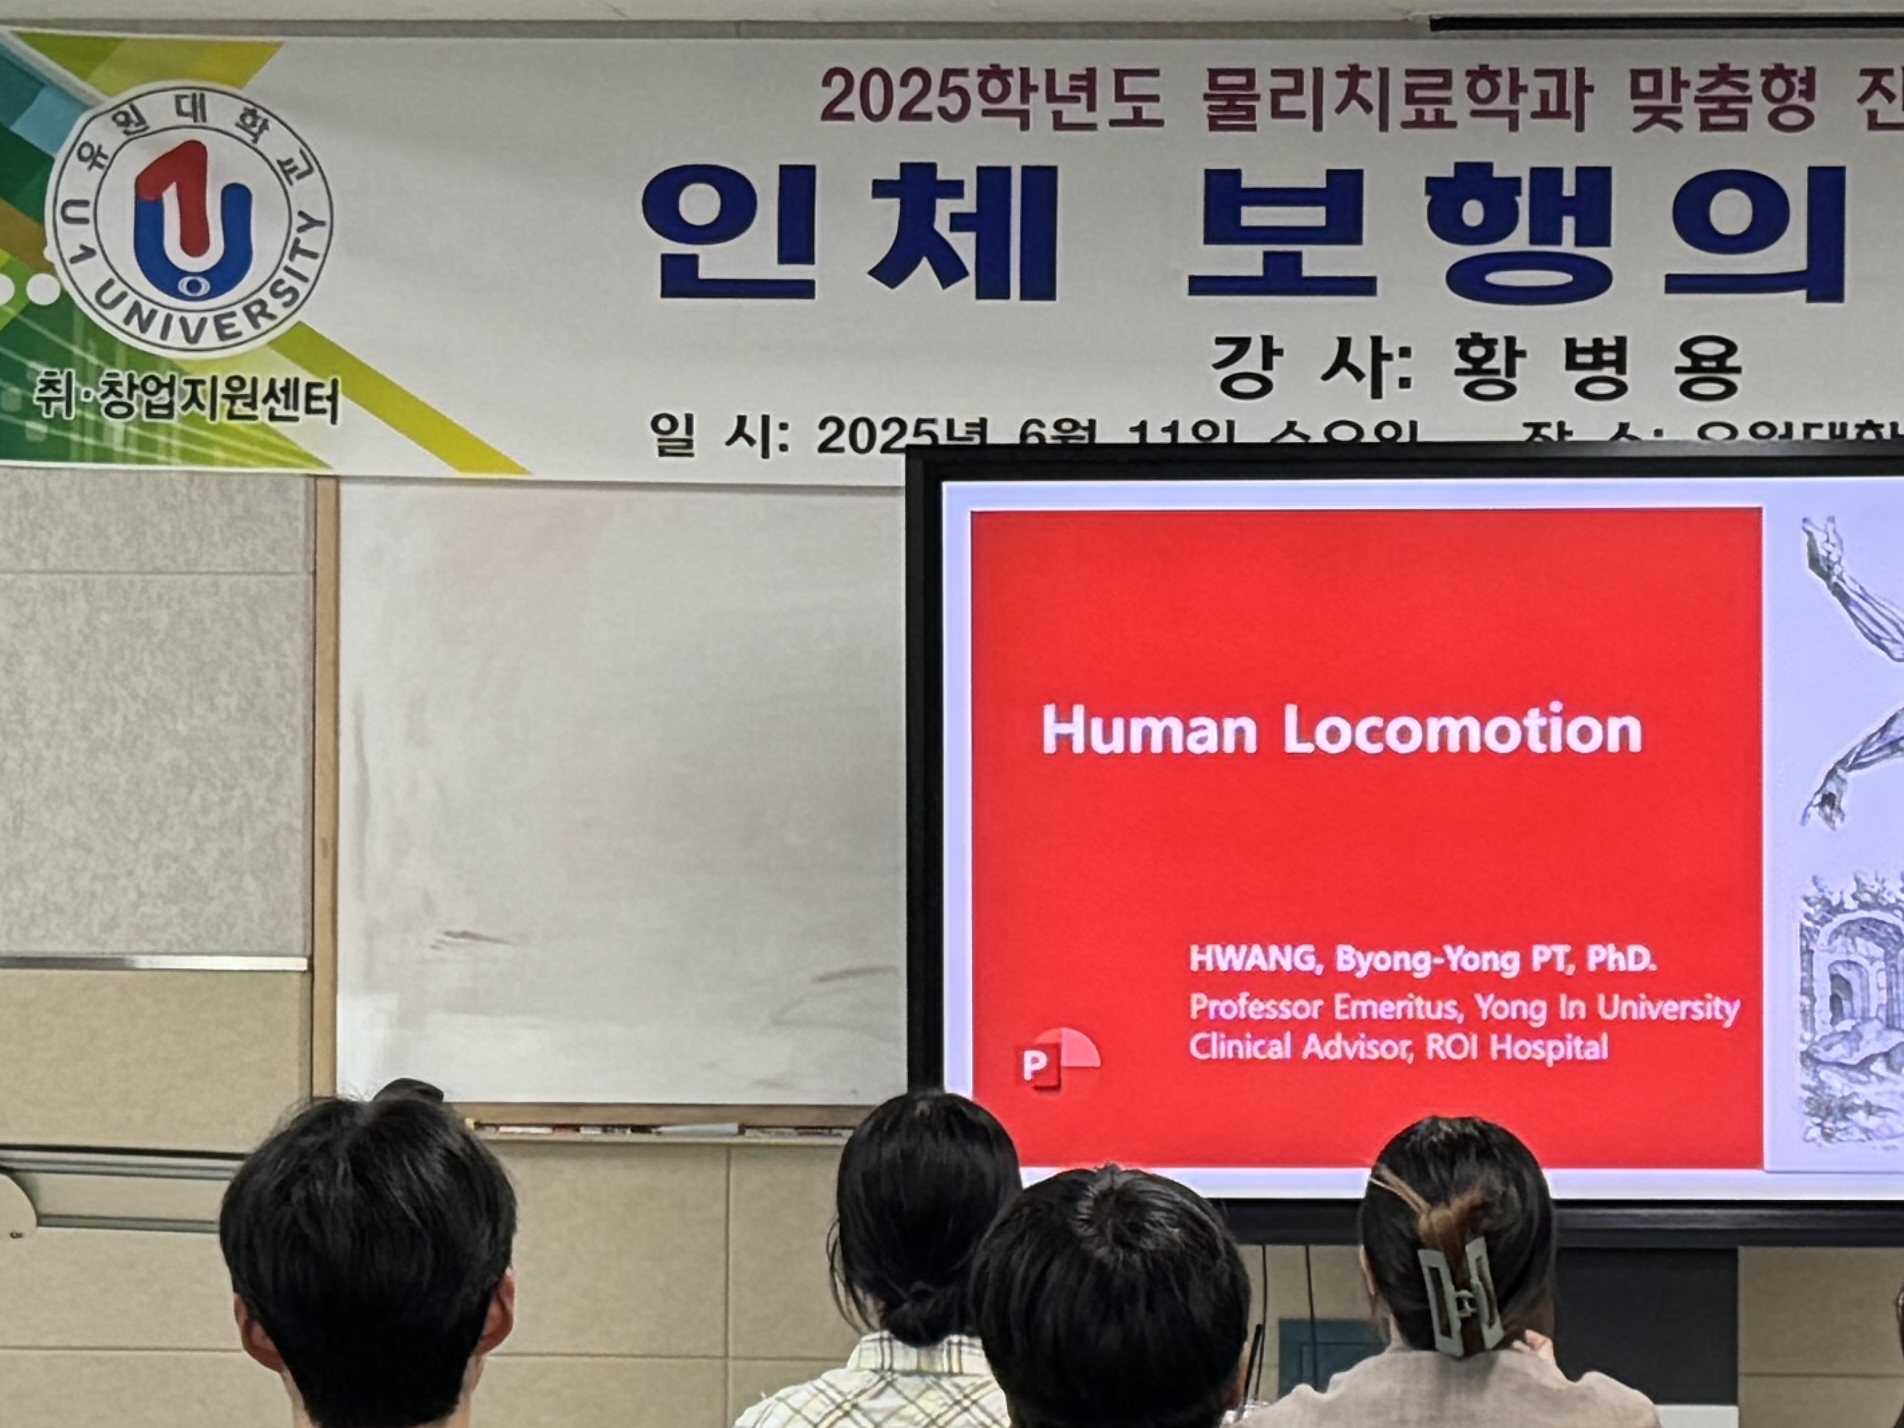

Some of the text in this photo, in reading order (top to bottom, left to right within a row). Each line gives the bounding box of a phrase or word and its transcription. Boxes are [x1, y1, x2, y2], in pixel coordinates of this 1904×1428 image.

[819, 62, 1166, 133] 2025학년도
[1202, 61, 1594, 134] 물리치료학과
[1628, 61, 1818, 134] 맞춤형
[76, 92, 316, 187] 유원대학교
[641, 161, 1059, 302] 인체
[1187, 160, 1847, 307] 보행의
[94, 210, 327, 346] UNIVERSITY
[1043, 700, 1642, 755] Human Locomotion
[1190, 943, 1657, 979] HWANG, Byong-Yong PT, PhD.
[1190, 991, 1741, 1028] Professor Emeritus, Yong In University
[1189, 1030, 1609, 1068] Clinical Advisor, ROI Hospital
